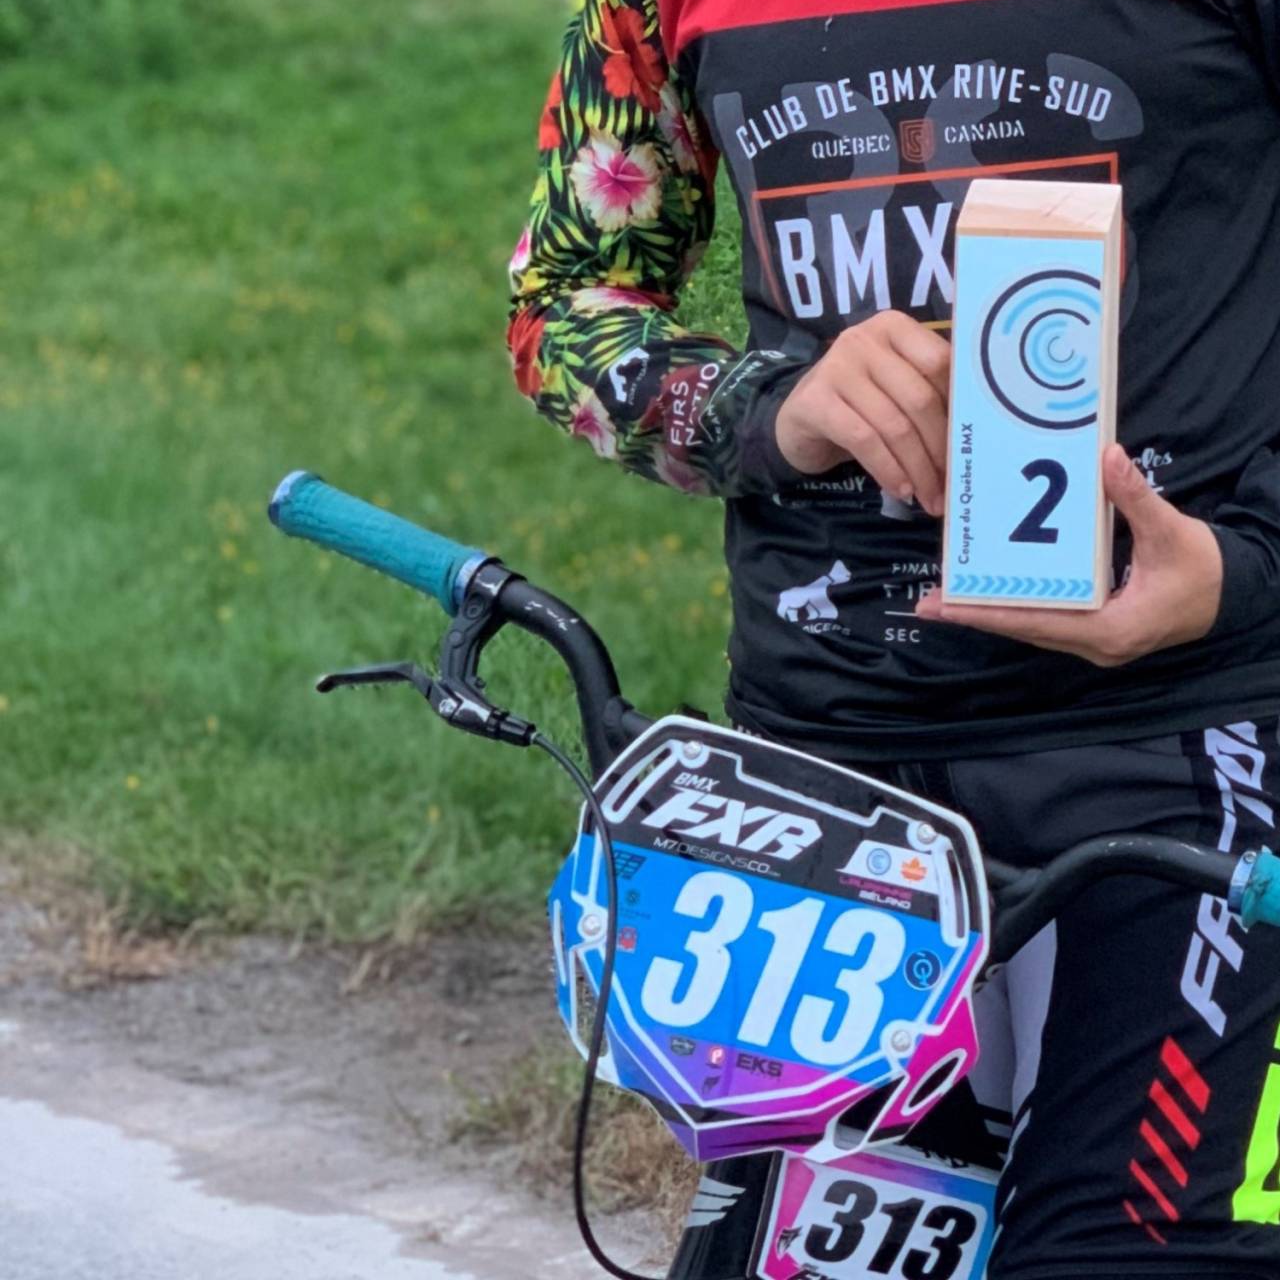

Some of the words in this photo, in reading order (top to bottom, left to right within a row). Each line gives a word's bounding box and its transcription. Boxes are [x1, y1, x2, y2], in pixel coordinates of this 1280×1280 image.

[736, 95, 807, 160] CLUB
[815, 78, 857, 120] DE
[869, 64, 937, 106] BMX
[954, 64, 1112, 122] RIVE-SUD
[811, 133, 891, 160] QUÉBEC
[944, 120, 1025, 144] CANADA
[775, 202, 953, 319] BMX
[961, 423, 973, 455] BMX
[959, 459, 974, 504] Québec
[1008, 458, 1068, 544] 2
[959, 507, 971, 523] du
[957, 526, 973, 565] Coupe
[884, 627, 921, 643] SEC
[672, 771, 719, 793] BMX
[641, 871, 906, 1066] 313
[736, 1053, 783, 1078] EKS
[804, 1179, 978, 1280] 313
